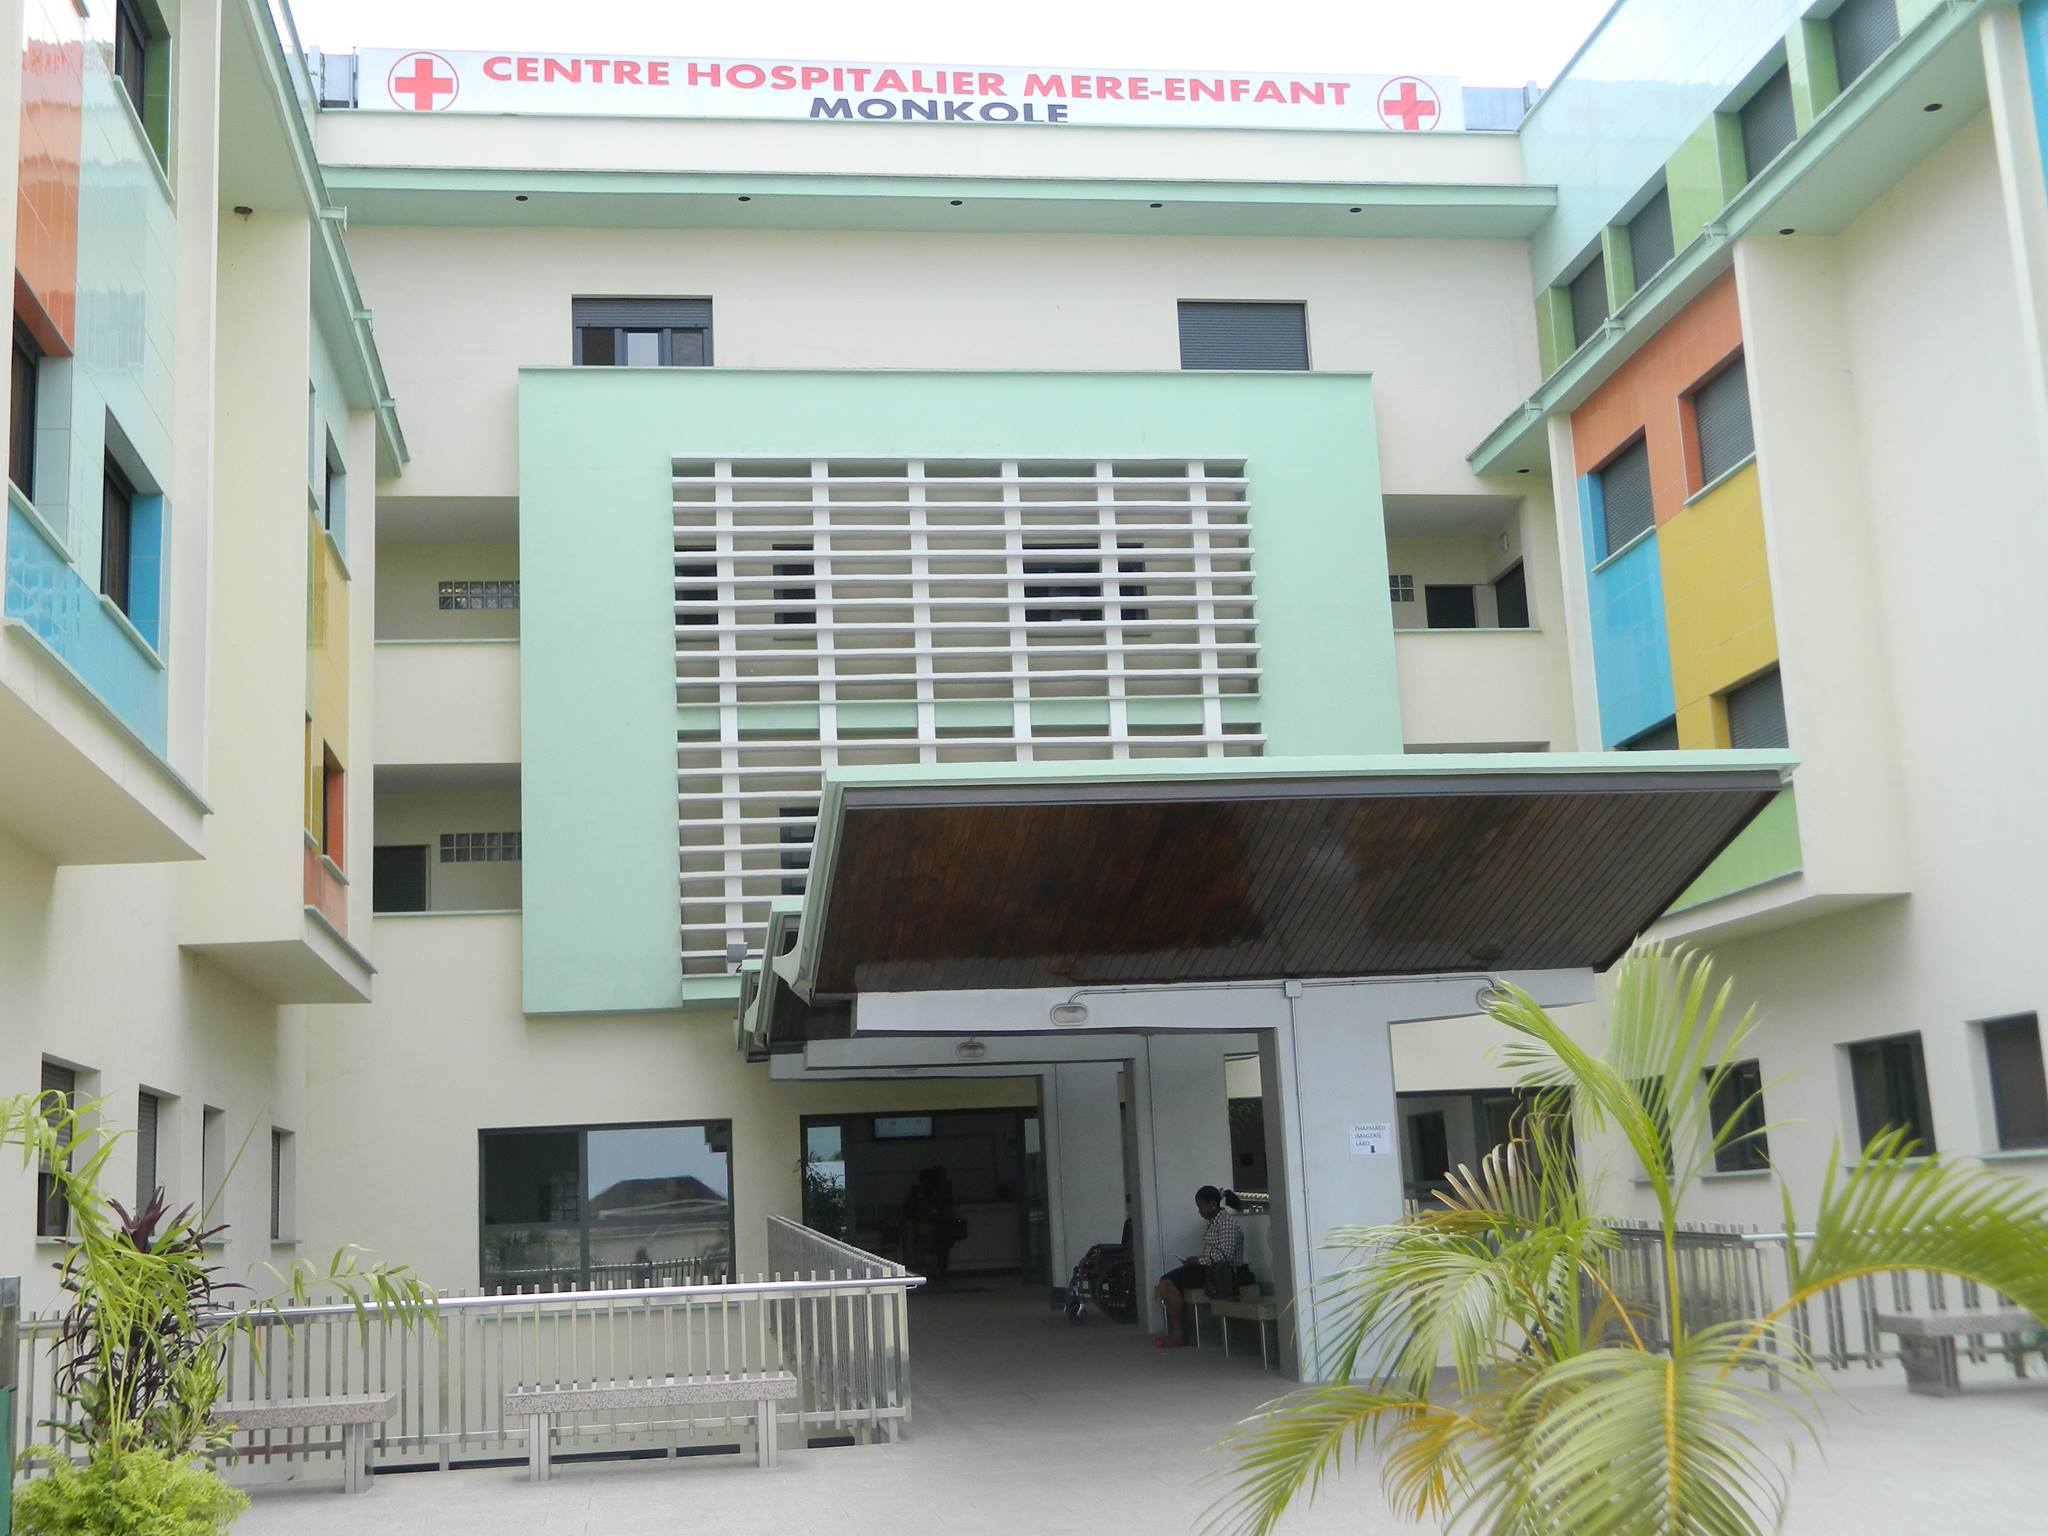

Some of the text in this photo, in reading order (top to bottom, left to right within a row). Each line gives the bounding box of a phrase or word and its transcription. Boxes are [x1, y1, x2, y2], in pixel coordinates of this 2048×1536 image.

[483, 56, 1351, 105] CENTRE HOSPITALIER MERE-ENFANT
[809, 97, 1068, 123] MONKOLE
